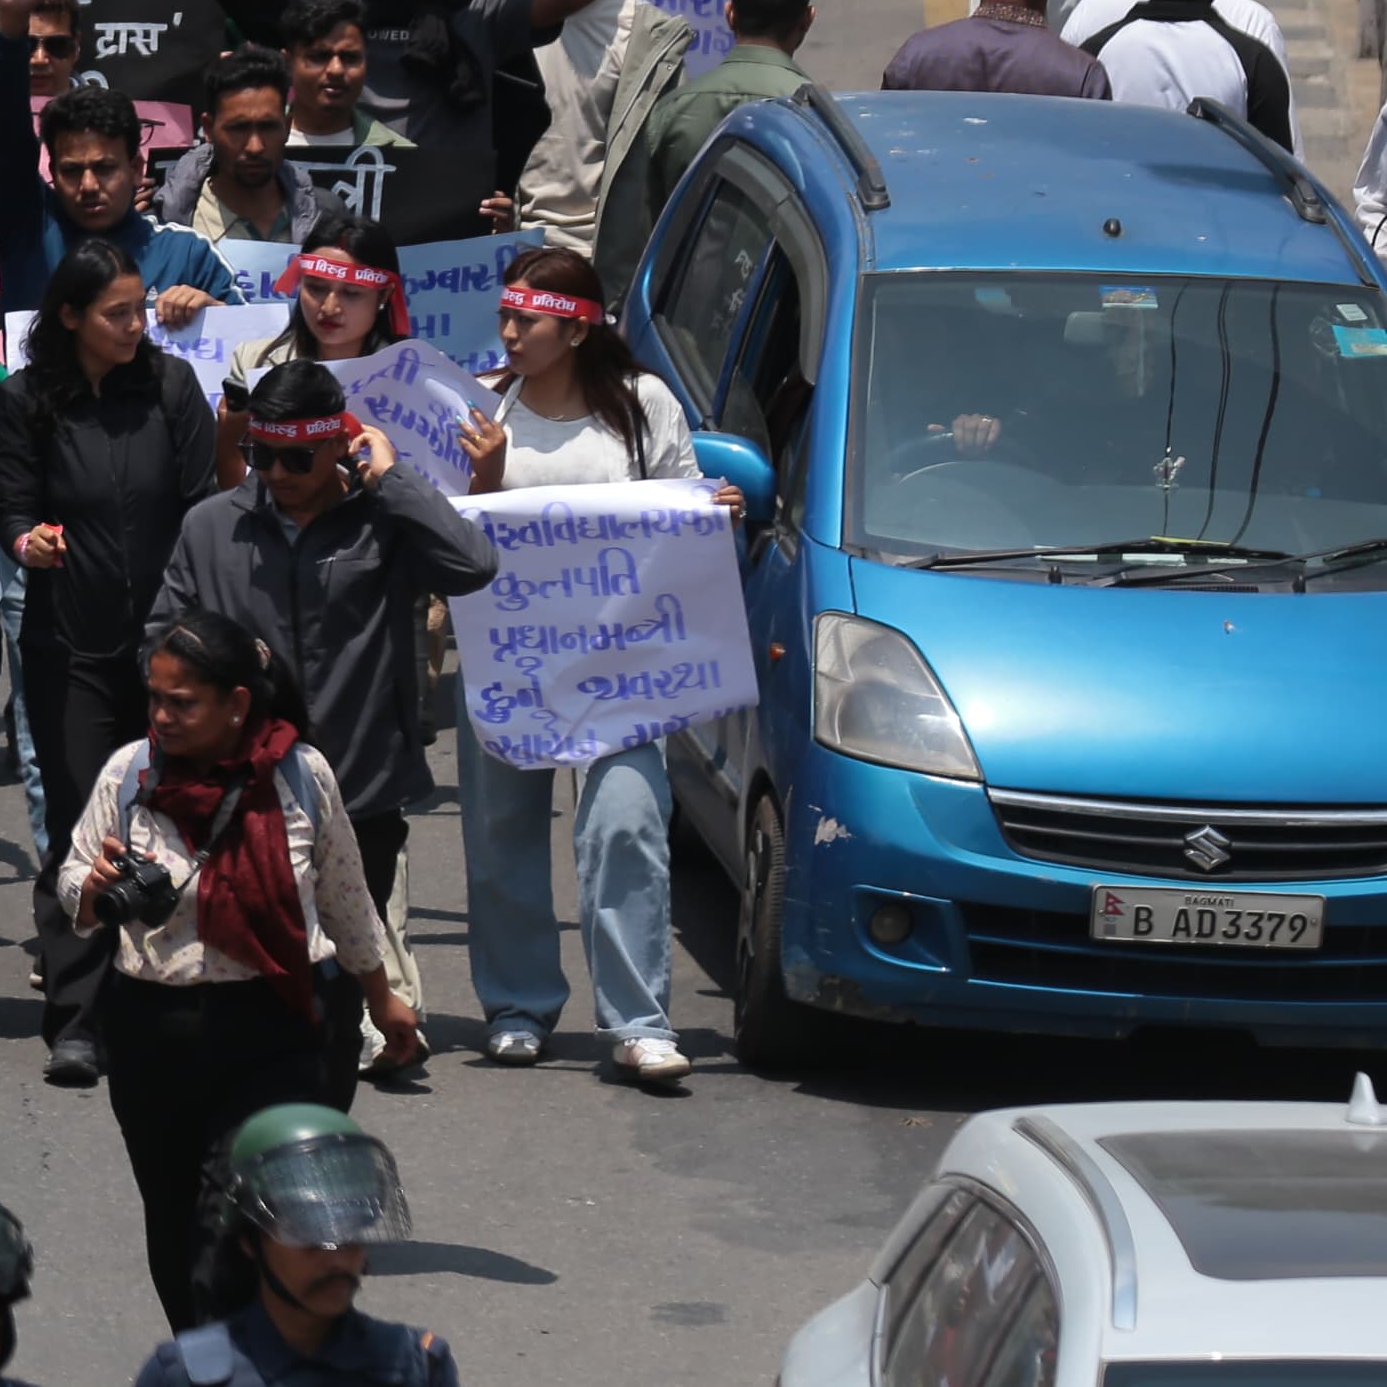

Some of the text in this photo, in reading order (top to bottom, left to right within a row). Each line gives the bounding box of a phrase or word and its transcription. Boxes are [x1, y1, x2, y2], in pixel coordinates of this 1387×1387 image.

[314, 259, 348, 280] विरुद्ध
[531, 292, 576, 313] प्रतिरोध
[491, 547, 642, 612] कुलपति
[1184, 894, 1235, 908] BAGMATI
[1132, 904, 1155, 937] B
